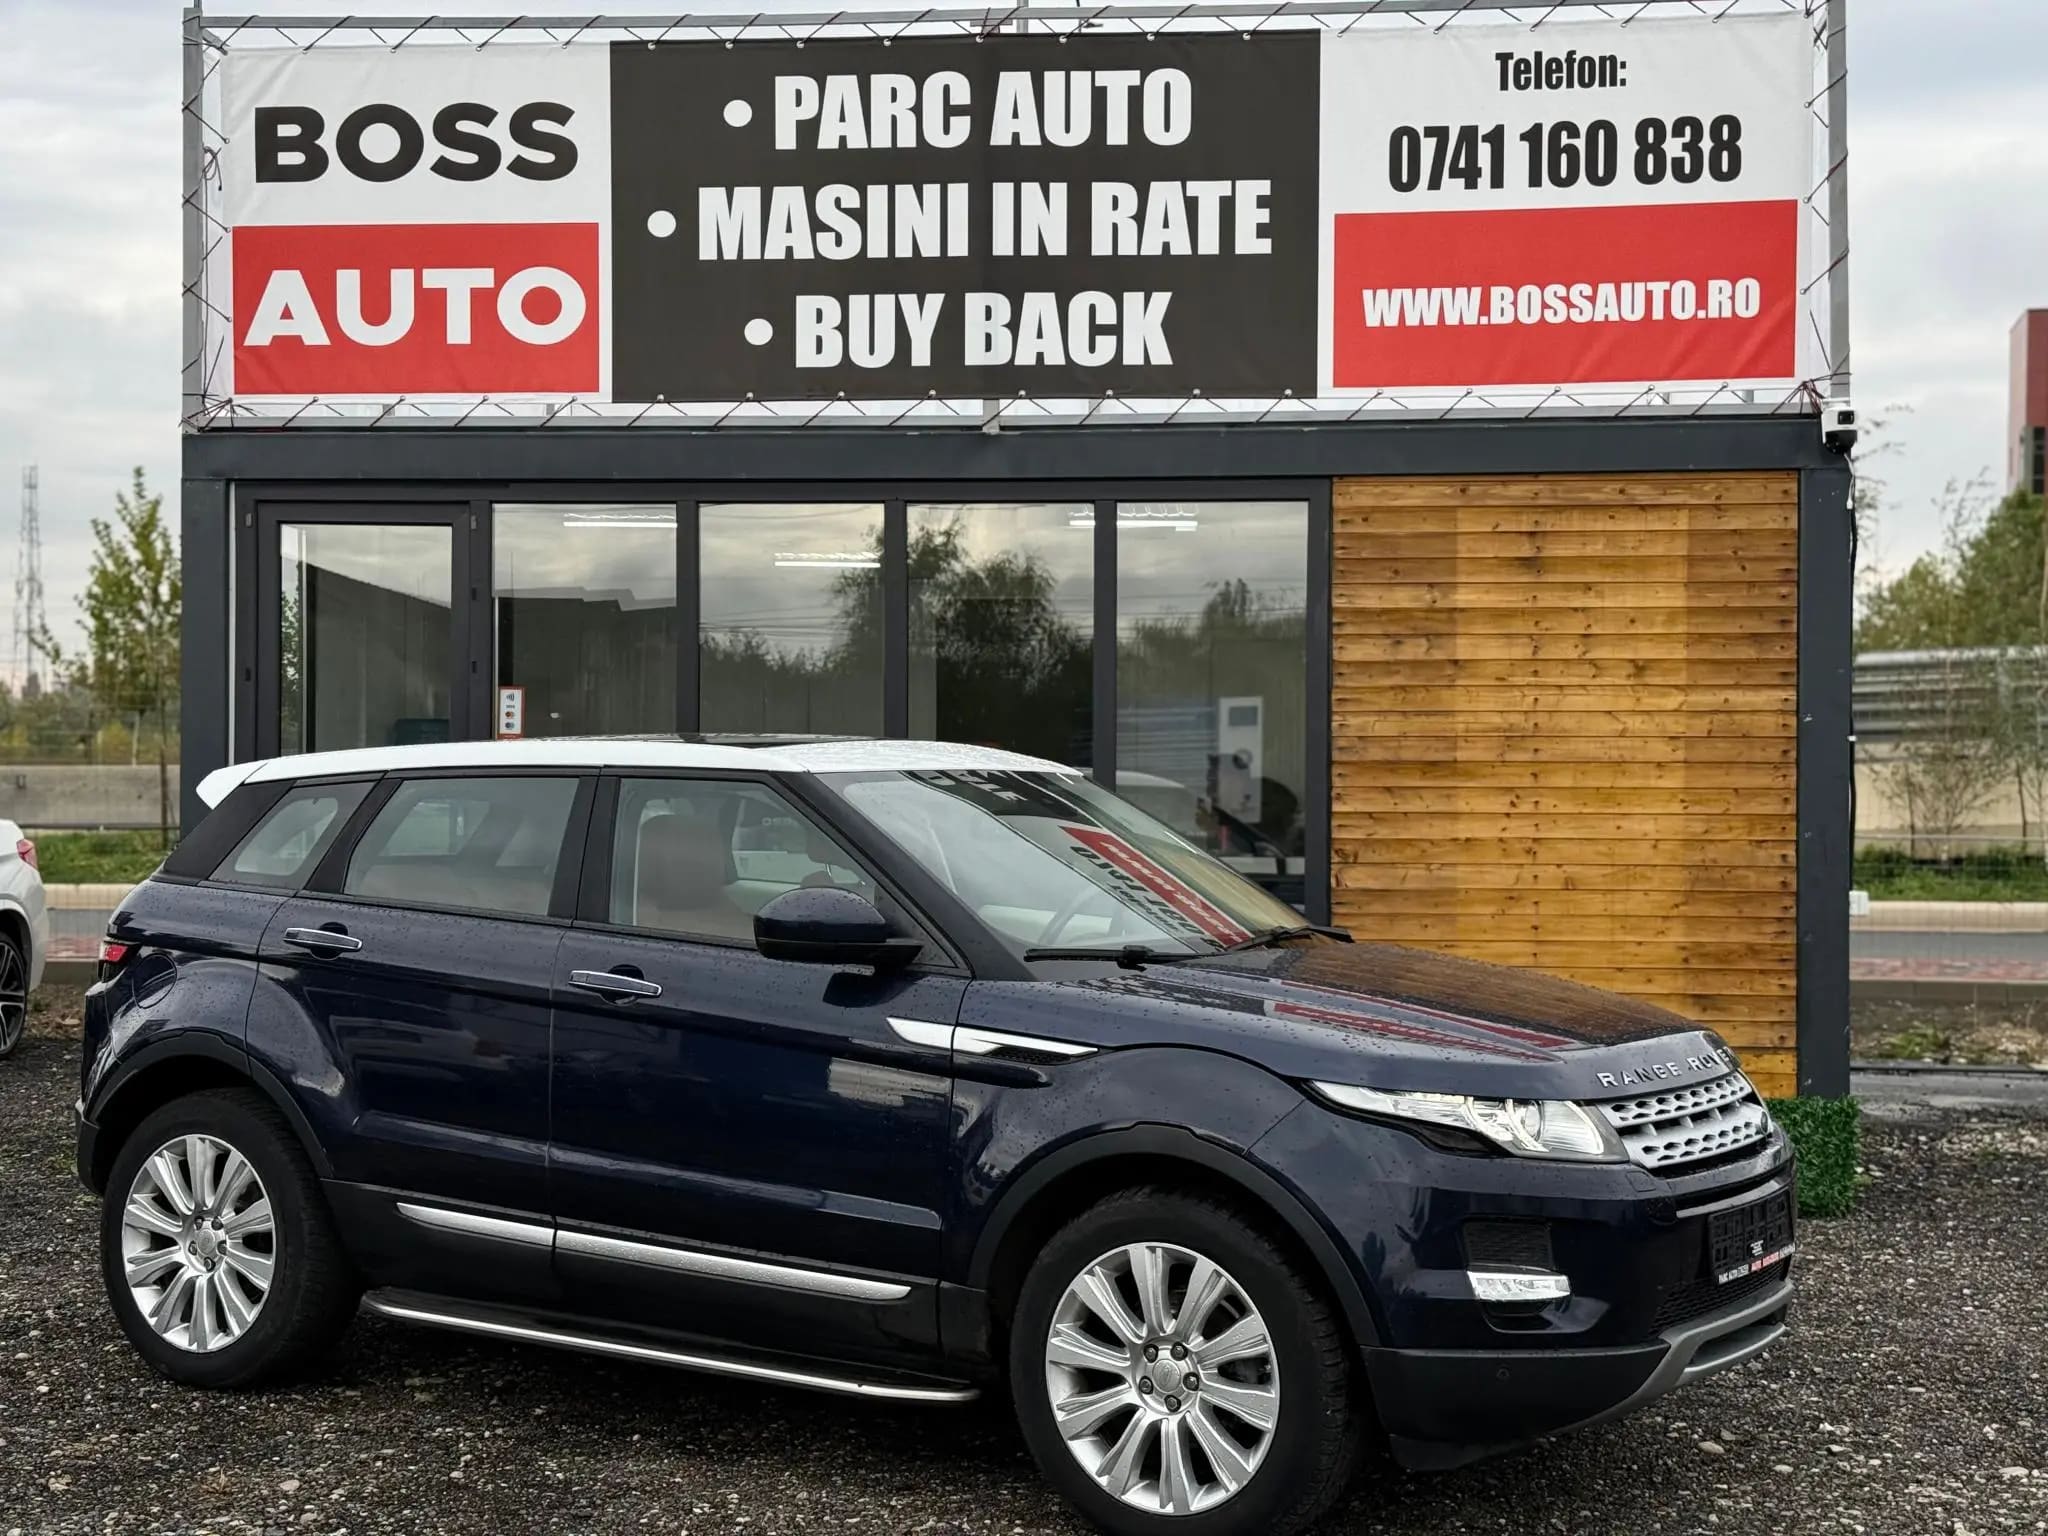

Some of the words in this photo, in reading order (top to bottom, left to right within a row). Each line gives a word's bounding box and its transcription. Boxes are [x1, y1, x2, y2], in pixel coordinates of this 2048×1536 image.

[774, 71, 971, 150] PARC
[989, 67, 1192, 147] AUTO
[1495, 50, 1627, 91] Telefon:
[254, 102, 579, 184] BOSS
[1388, 124, 1505, 193] 0741
[1519, 119, 1618, 188] 160
[1634, 114, 1742, 185] 838
[698, 182, 969, 261] MASINI
[992, 182, 1068, 256] IN
[1091, 179, 1272, 256] RATE
[243, 266, 587, 347] AUTO
[795, 293, 945, 369] BUY
[964, 290, 1173, 367] BACK
[1362, 277, 1761, 328] WWW.BOSSAUTO.RO
[1596, 1062, 1683, 1088] RANGE
